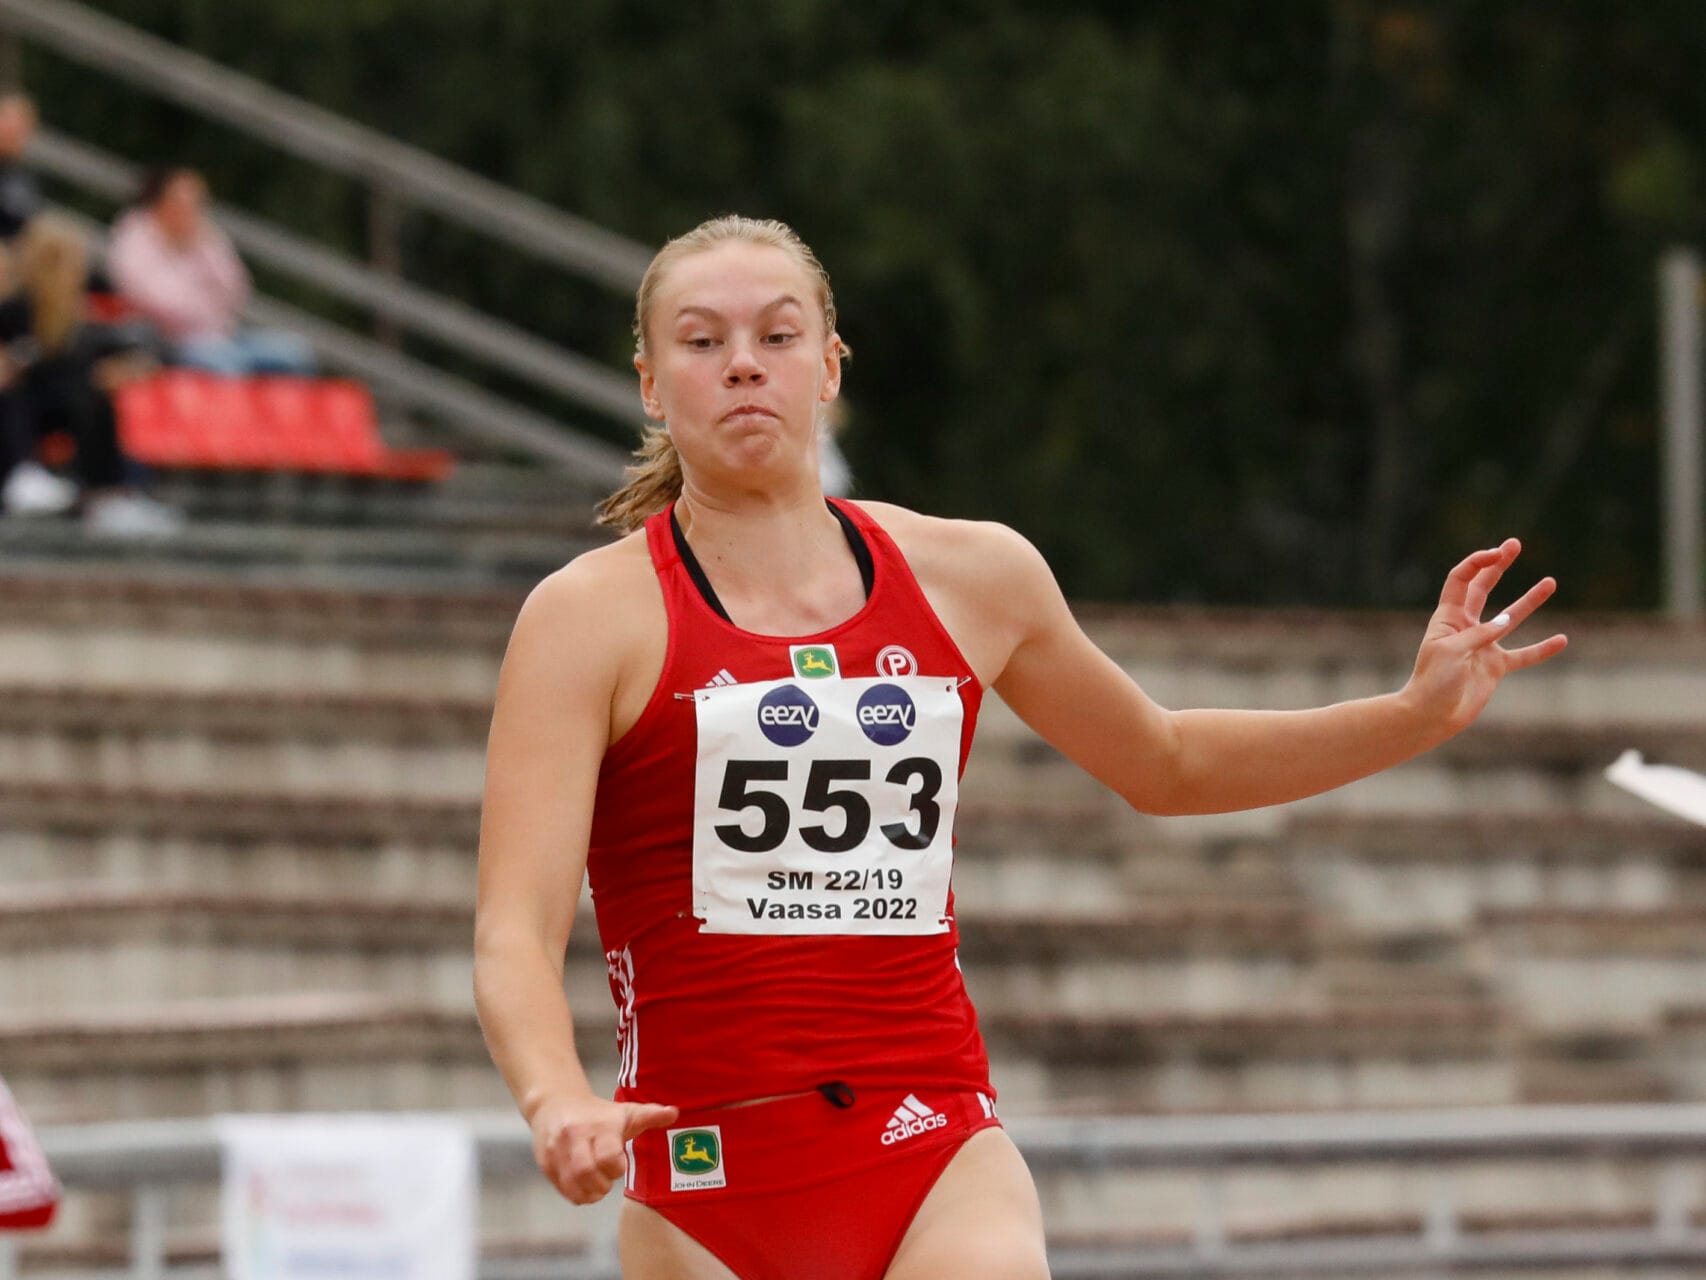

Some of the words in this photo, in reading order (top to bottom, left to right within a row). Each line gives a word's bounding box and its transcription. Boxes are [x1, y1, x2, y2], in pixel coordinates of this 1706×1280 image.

[760, 705, 817, 732] eezy
[859, 704, 915, 731] eezy
[714, 757, 942, 853] 553
[767, 870, 813, 890] SM
[824, 868, 903, 891] 22/19
[746, 898, 842, 919] Vaasa
[853, 898, 917, 919] 2022
[880, 1113, 948, 1146] adidas
[672, 1181, 695, 1189] JOHN
[696, 1179, 724, 1187] DEERE
